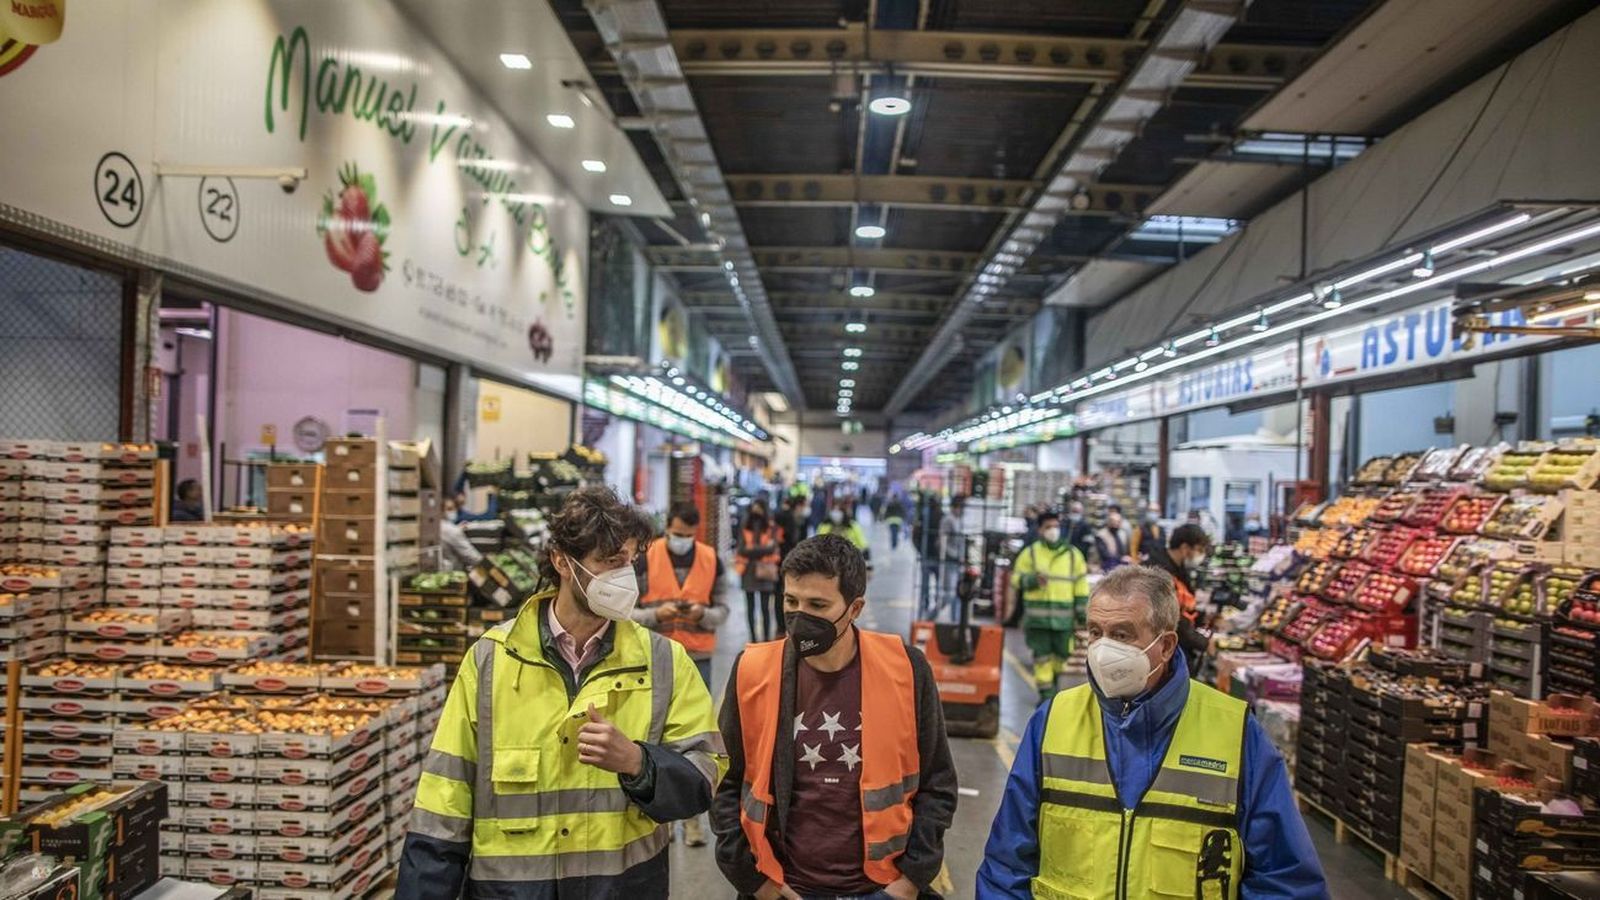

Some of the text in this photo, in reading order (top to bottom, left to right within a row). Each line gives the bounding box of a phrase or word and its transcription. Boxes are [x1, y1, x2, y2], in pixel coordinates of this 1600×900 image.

[265, 25, 417, 145] Manuel
[103, 169, 137, 212] 24
[207, 188, 231, 222] 22
